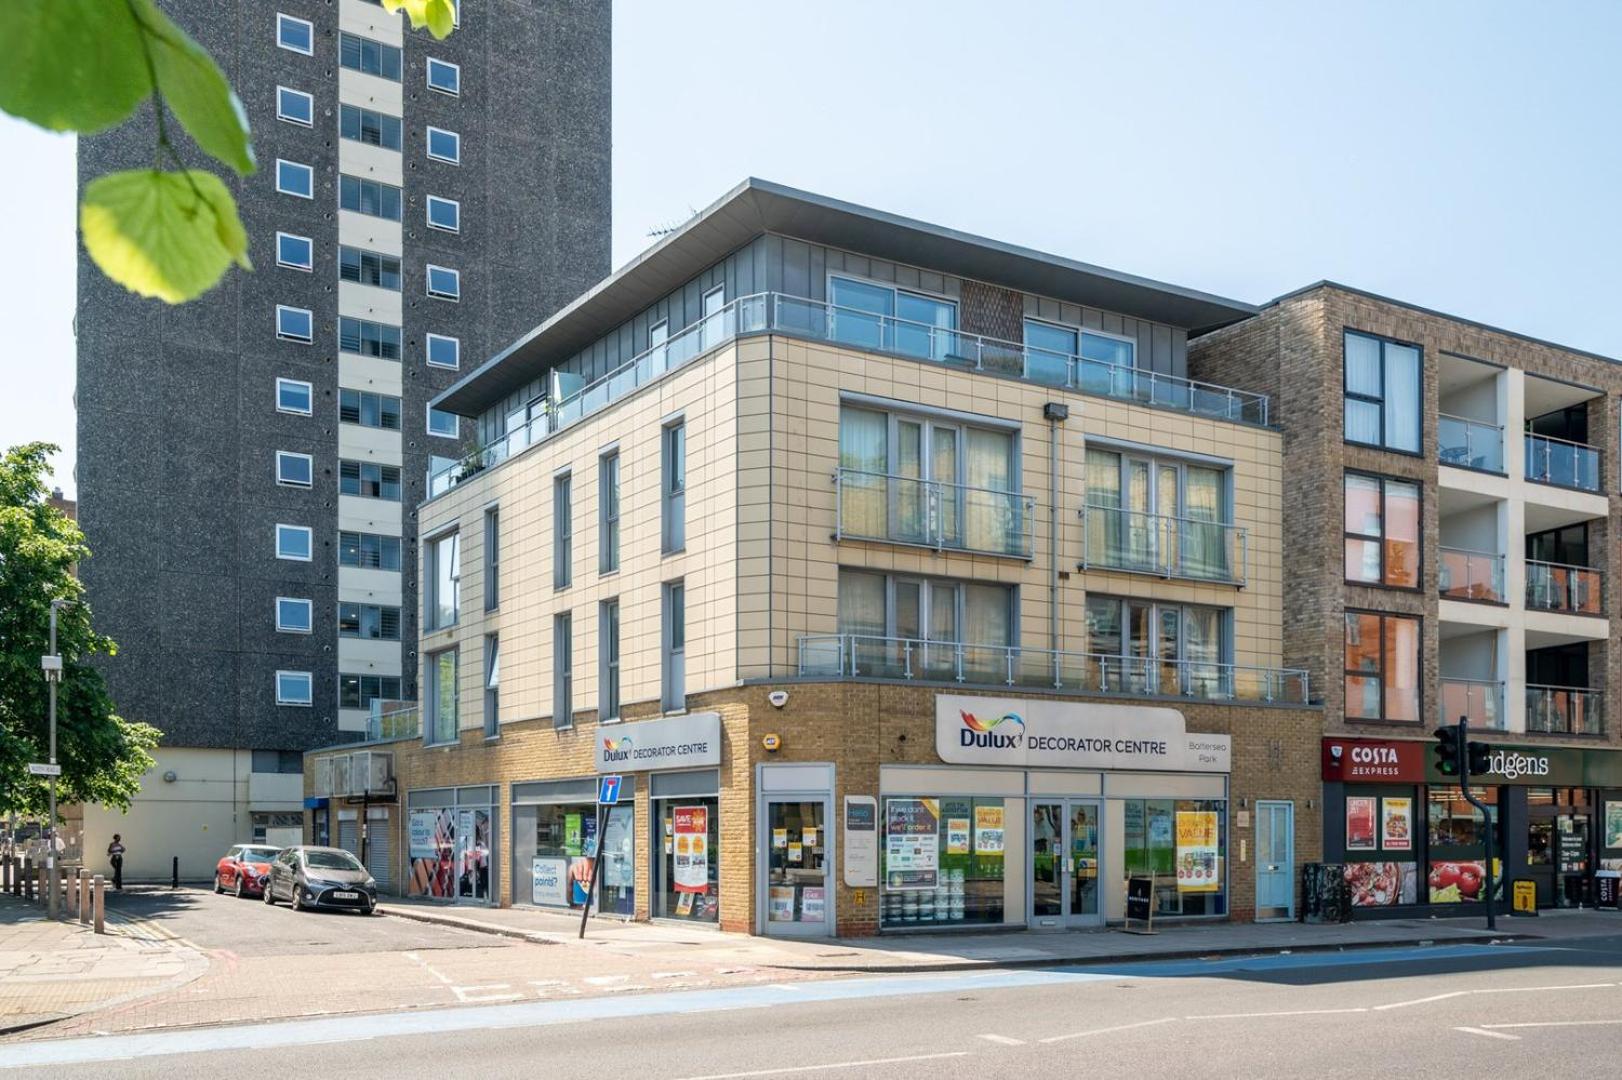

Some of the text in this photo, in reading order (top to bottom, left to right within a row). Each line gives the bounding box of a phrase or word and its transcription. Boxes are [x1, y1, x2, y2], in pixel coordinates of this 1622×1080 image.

[960, 728, 1167, 755] Dulux DECORATOR CENTRE
[604, 742, 708, 762] Dulux DECORATOR CENTRE
[1199, 754, 1217, 764] Park
[1351, 747, 1398, 765] COSTA
[1359, 766, 1399, 775] EXPRESS
[1481, 750, 1549, 780] dgens
[1600, 878, 1609, 902] COSTA
